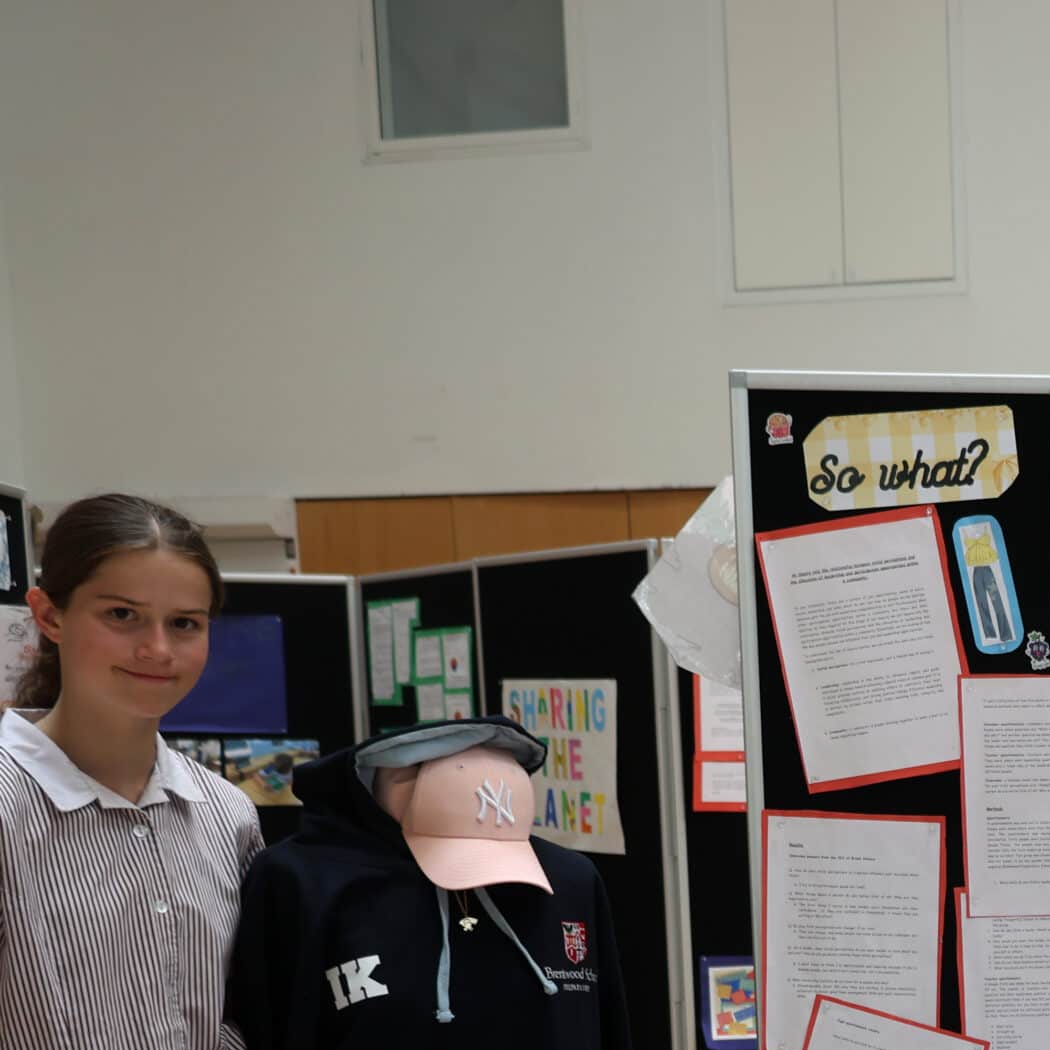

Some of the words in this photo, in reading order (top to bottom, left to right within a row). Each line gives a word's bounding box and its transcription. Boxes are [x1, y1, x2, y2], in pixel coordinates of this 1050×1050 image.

[810, 453, 866, 495] So
[879, 438, 990, 491] what?
[509, 687, 606, 733] SHARING
[532, 788, 606, 836] ANET
[325, 954, 389, 1011] IK
